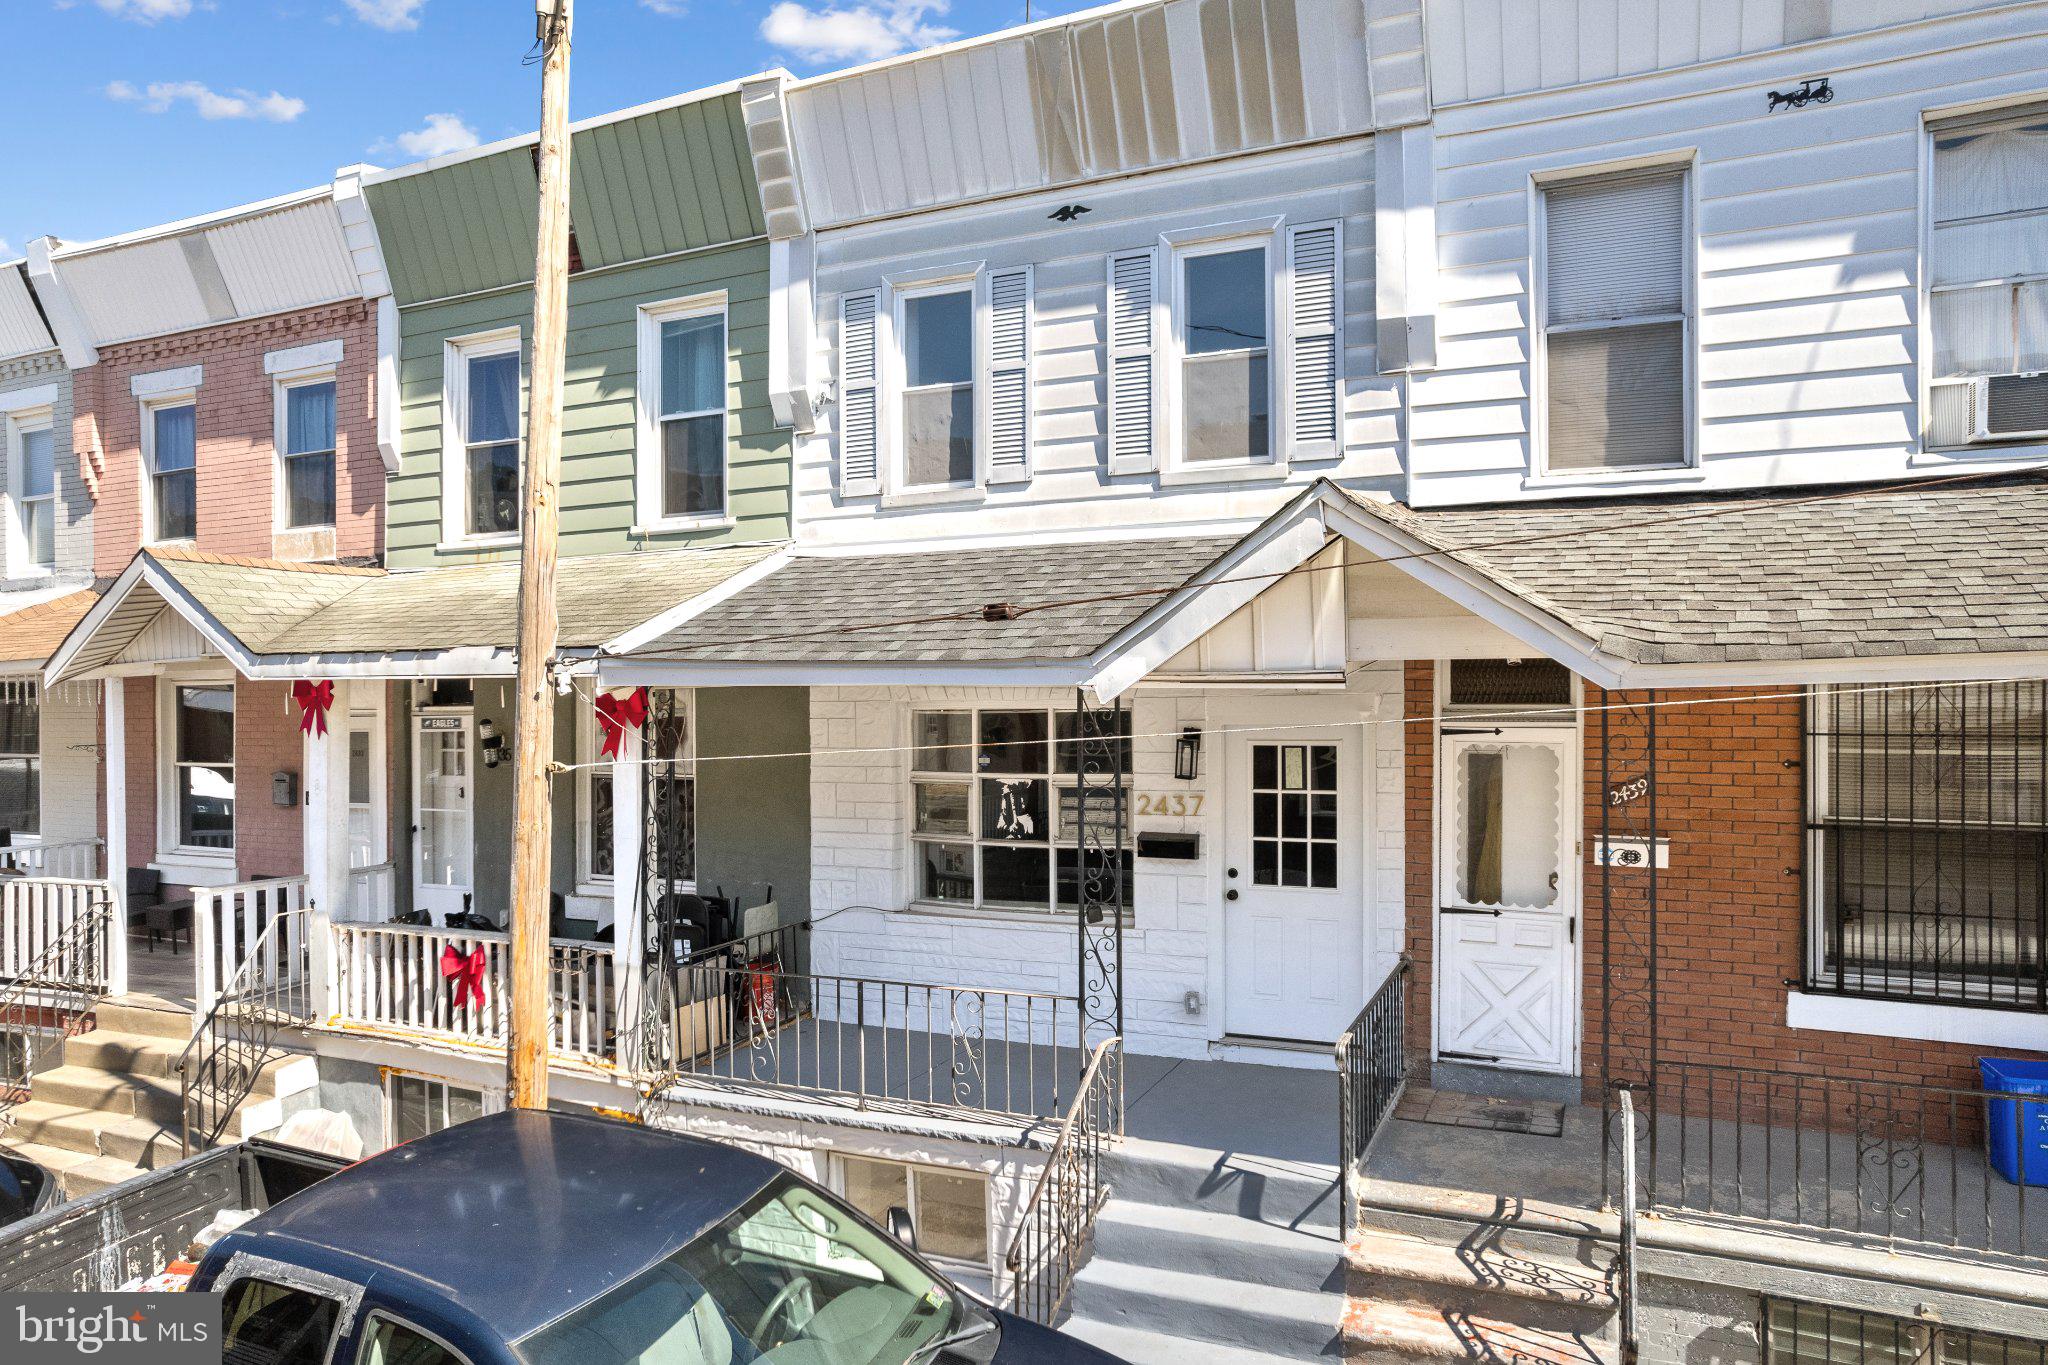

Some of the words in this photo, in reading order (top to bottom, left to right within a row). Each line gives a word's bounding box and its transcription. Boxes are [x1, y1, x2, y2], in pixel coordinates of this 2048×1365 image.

[432, 719, 455, 728] EAGLES
[1610, 778, 1648, 805] 2439
[1137, 793, 1204, 817] 2437
